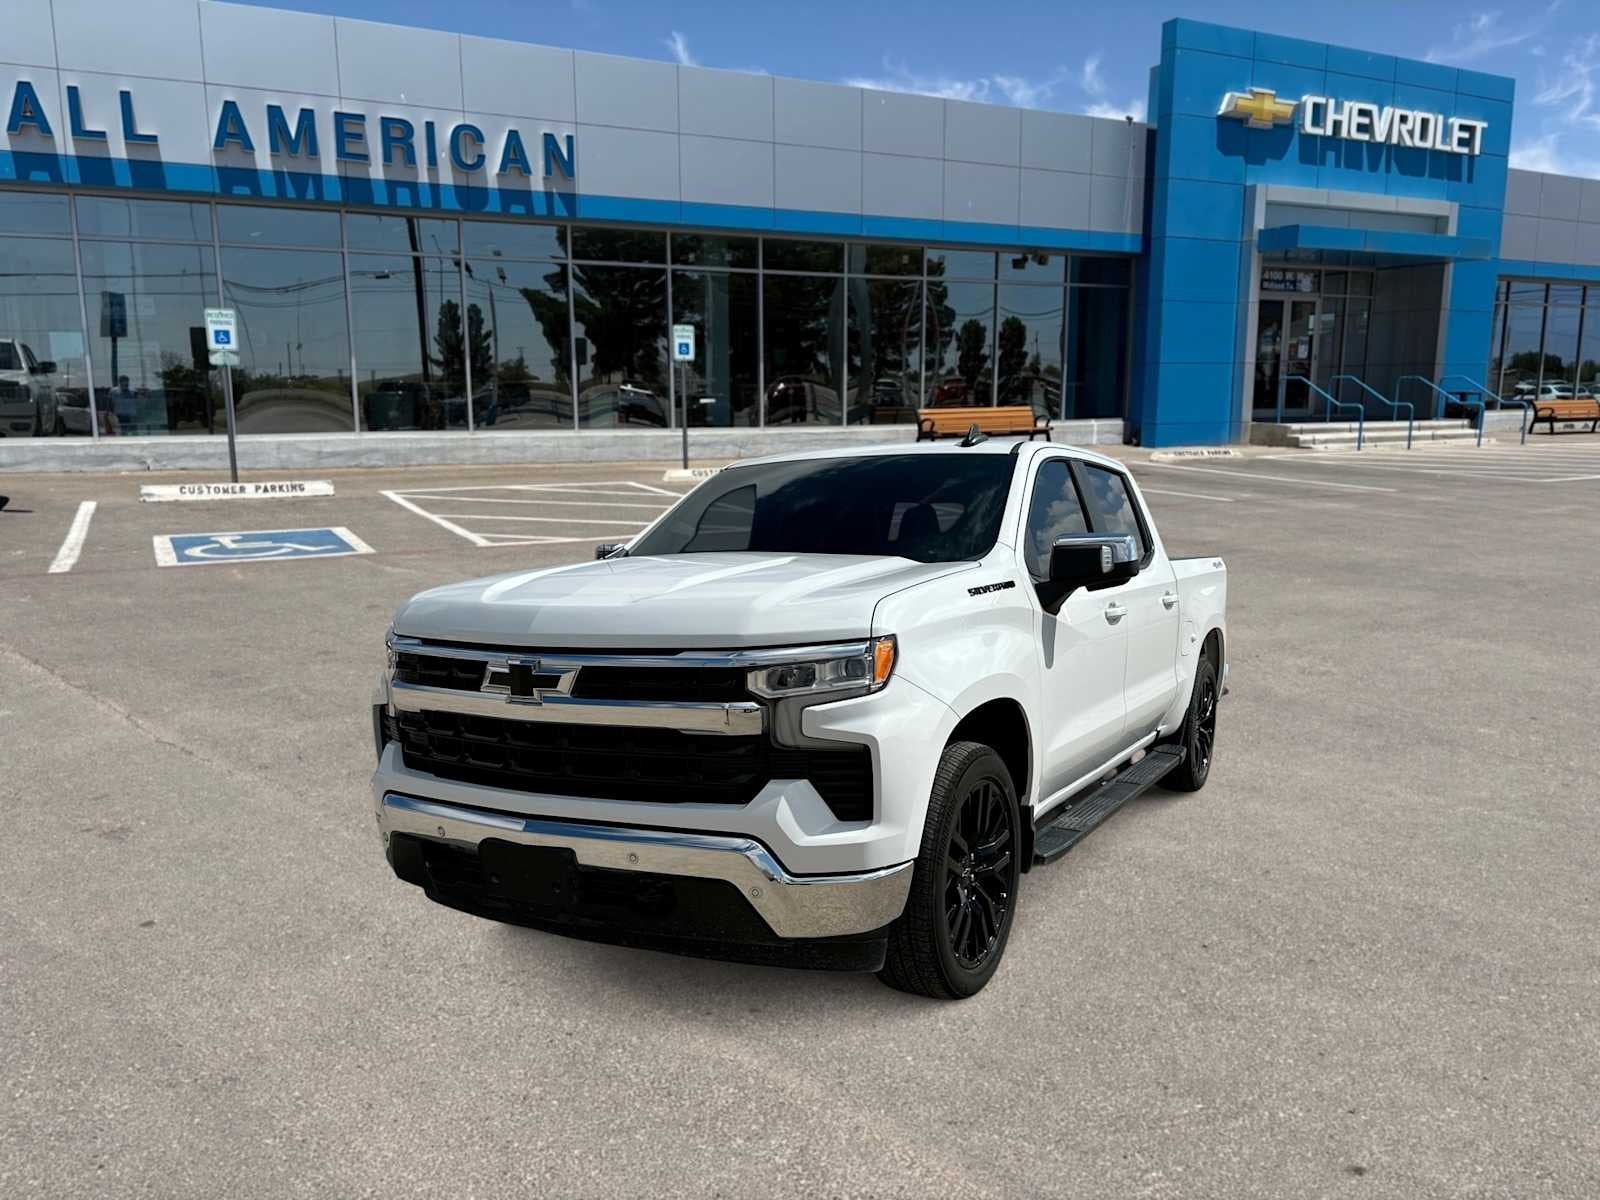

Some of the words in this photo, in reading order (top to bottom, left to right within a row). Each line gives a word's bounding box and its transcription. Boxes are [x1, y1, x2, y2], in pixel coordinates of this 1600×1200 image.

[6, 80, 159, 144] ALL
[213, 99, 576, 179] AMERICAN
[1301, 94, 1489, 156] CHEVROLET
[179, 485, 246, 496] CUSTOMER
[254, 482, 306, 494] PARKING
